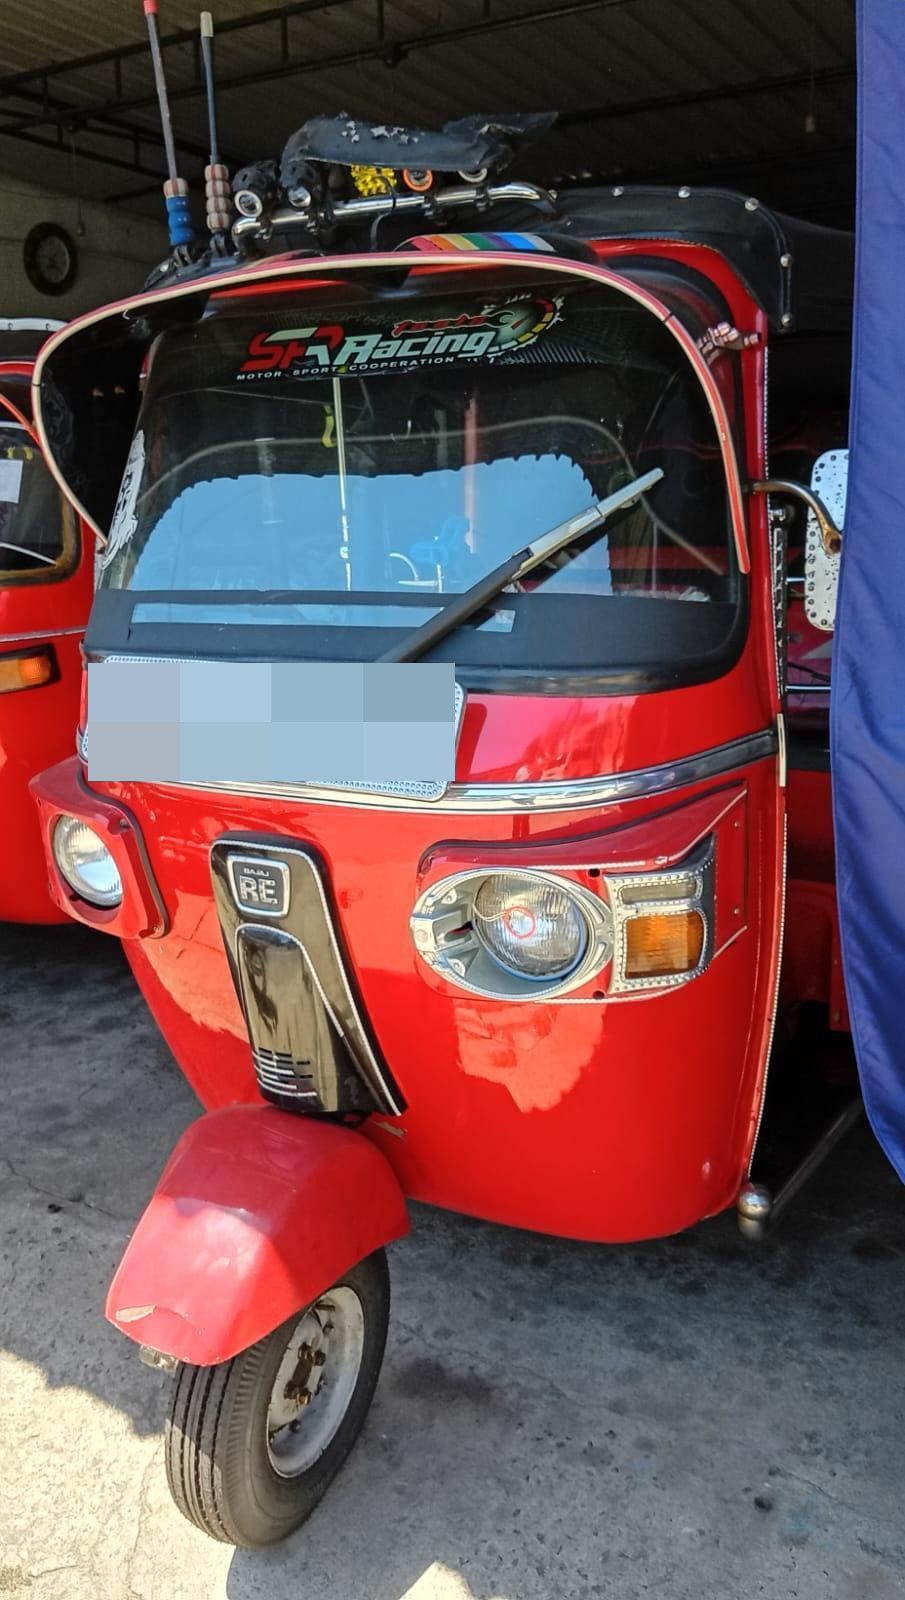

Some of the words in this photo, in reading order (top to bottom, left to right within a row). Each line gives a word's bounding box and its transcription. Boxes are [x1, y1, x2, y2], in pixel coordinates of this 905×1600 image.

[332, 331, 497, 366] Racing
[236, 371, 282, 380] MOTOR
[292, 366, 338, 376] SPORT
[349, 357, 454, 371] COOPERATION
[243, 867, 270, 877] BAJAJ
[240, 875, 278, 905] RE
